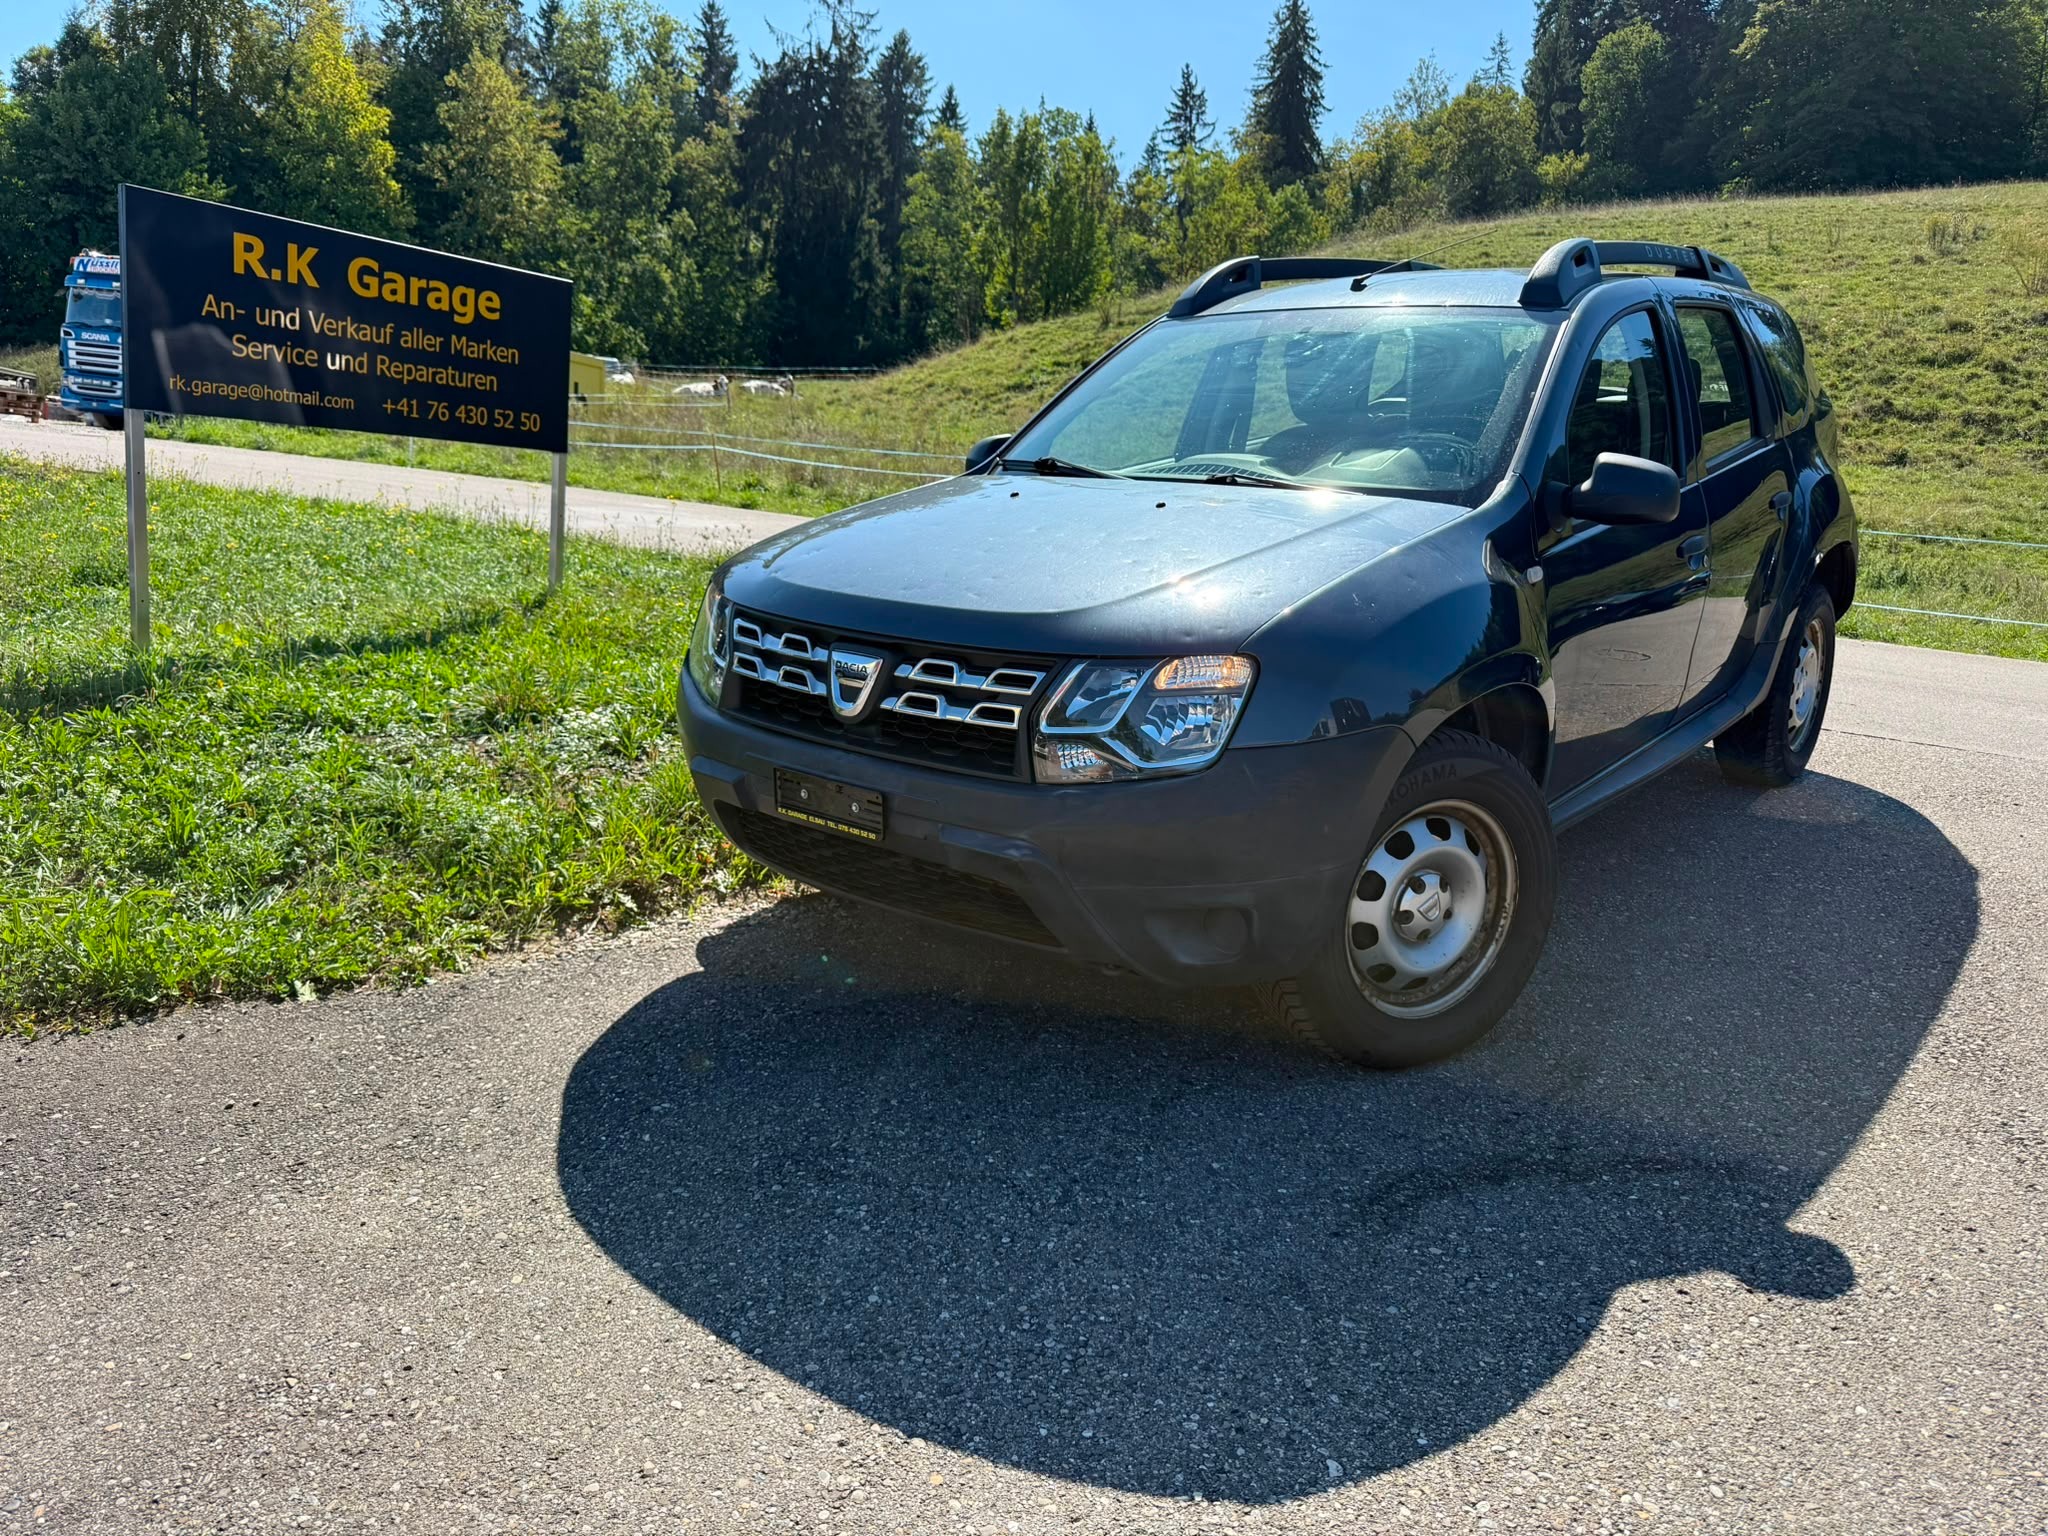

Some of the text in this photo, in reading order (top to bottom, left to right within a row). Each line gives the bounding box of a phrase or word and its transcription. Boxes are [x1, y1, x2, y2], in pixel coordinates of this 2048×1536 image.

[1645, 245, 1698, 264] DUSTER
[232, 231, 501, 325] R.K Garage
[81, 331, 111, 342] SCANIA
[202, 293, 519, 365] An- und Verkauf aller Marken
[231, 334, 498, 393] Service und Reparaturen
[168, 375, 355, 410] rk.garage@hotmail.com
[382, 398, 542, 433] +41 76 430 52 50
[835, 660, 868, 675] DACIA
[787, 809, 808, 821] GARAGE
